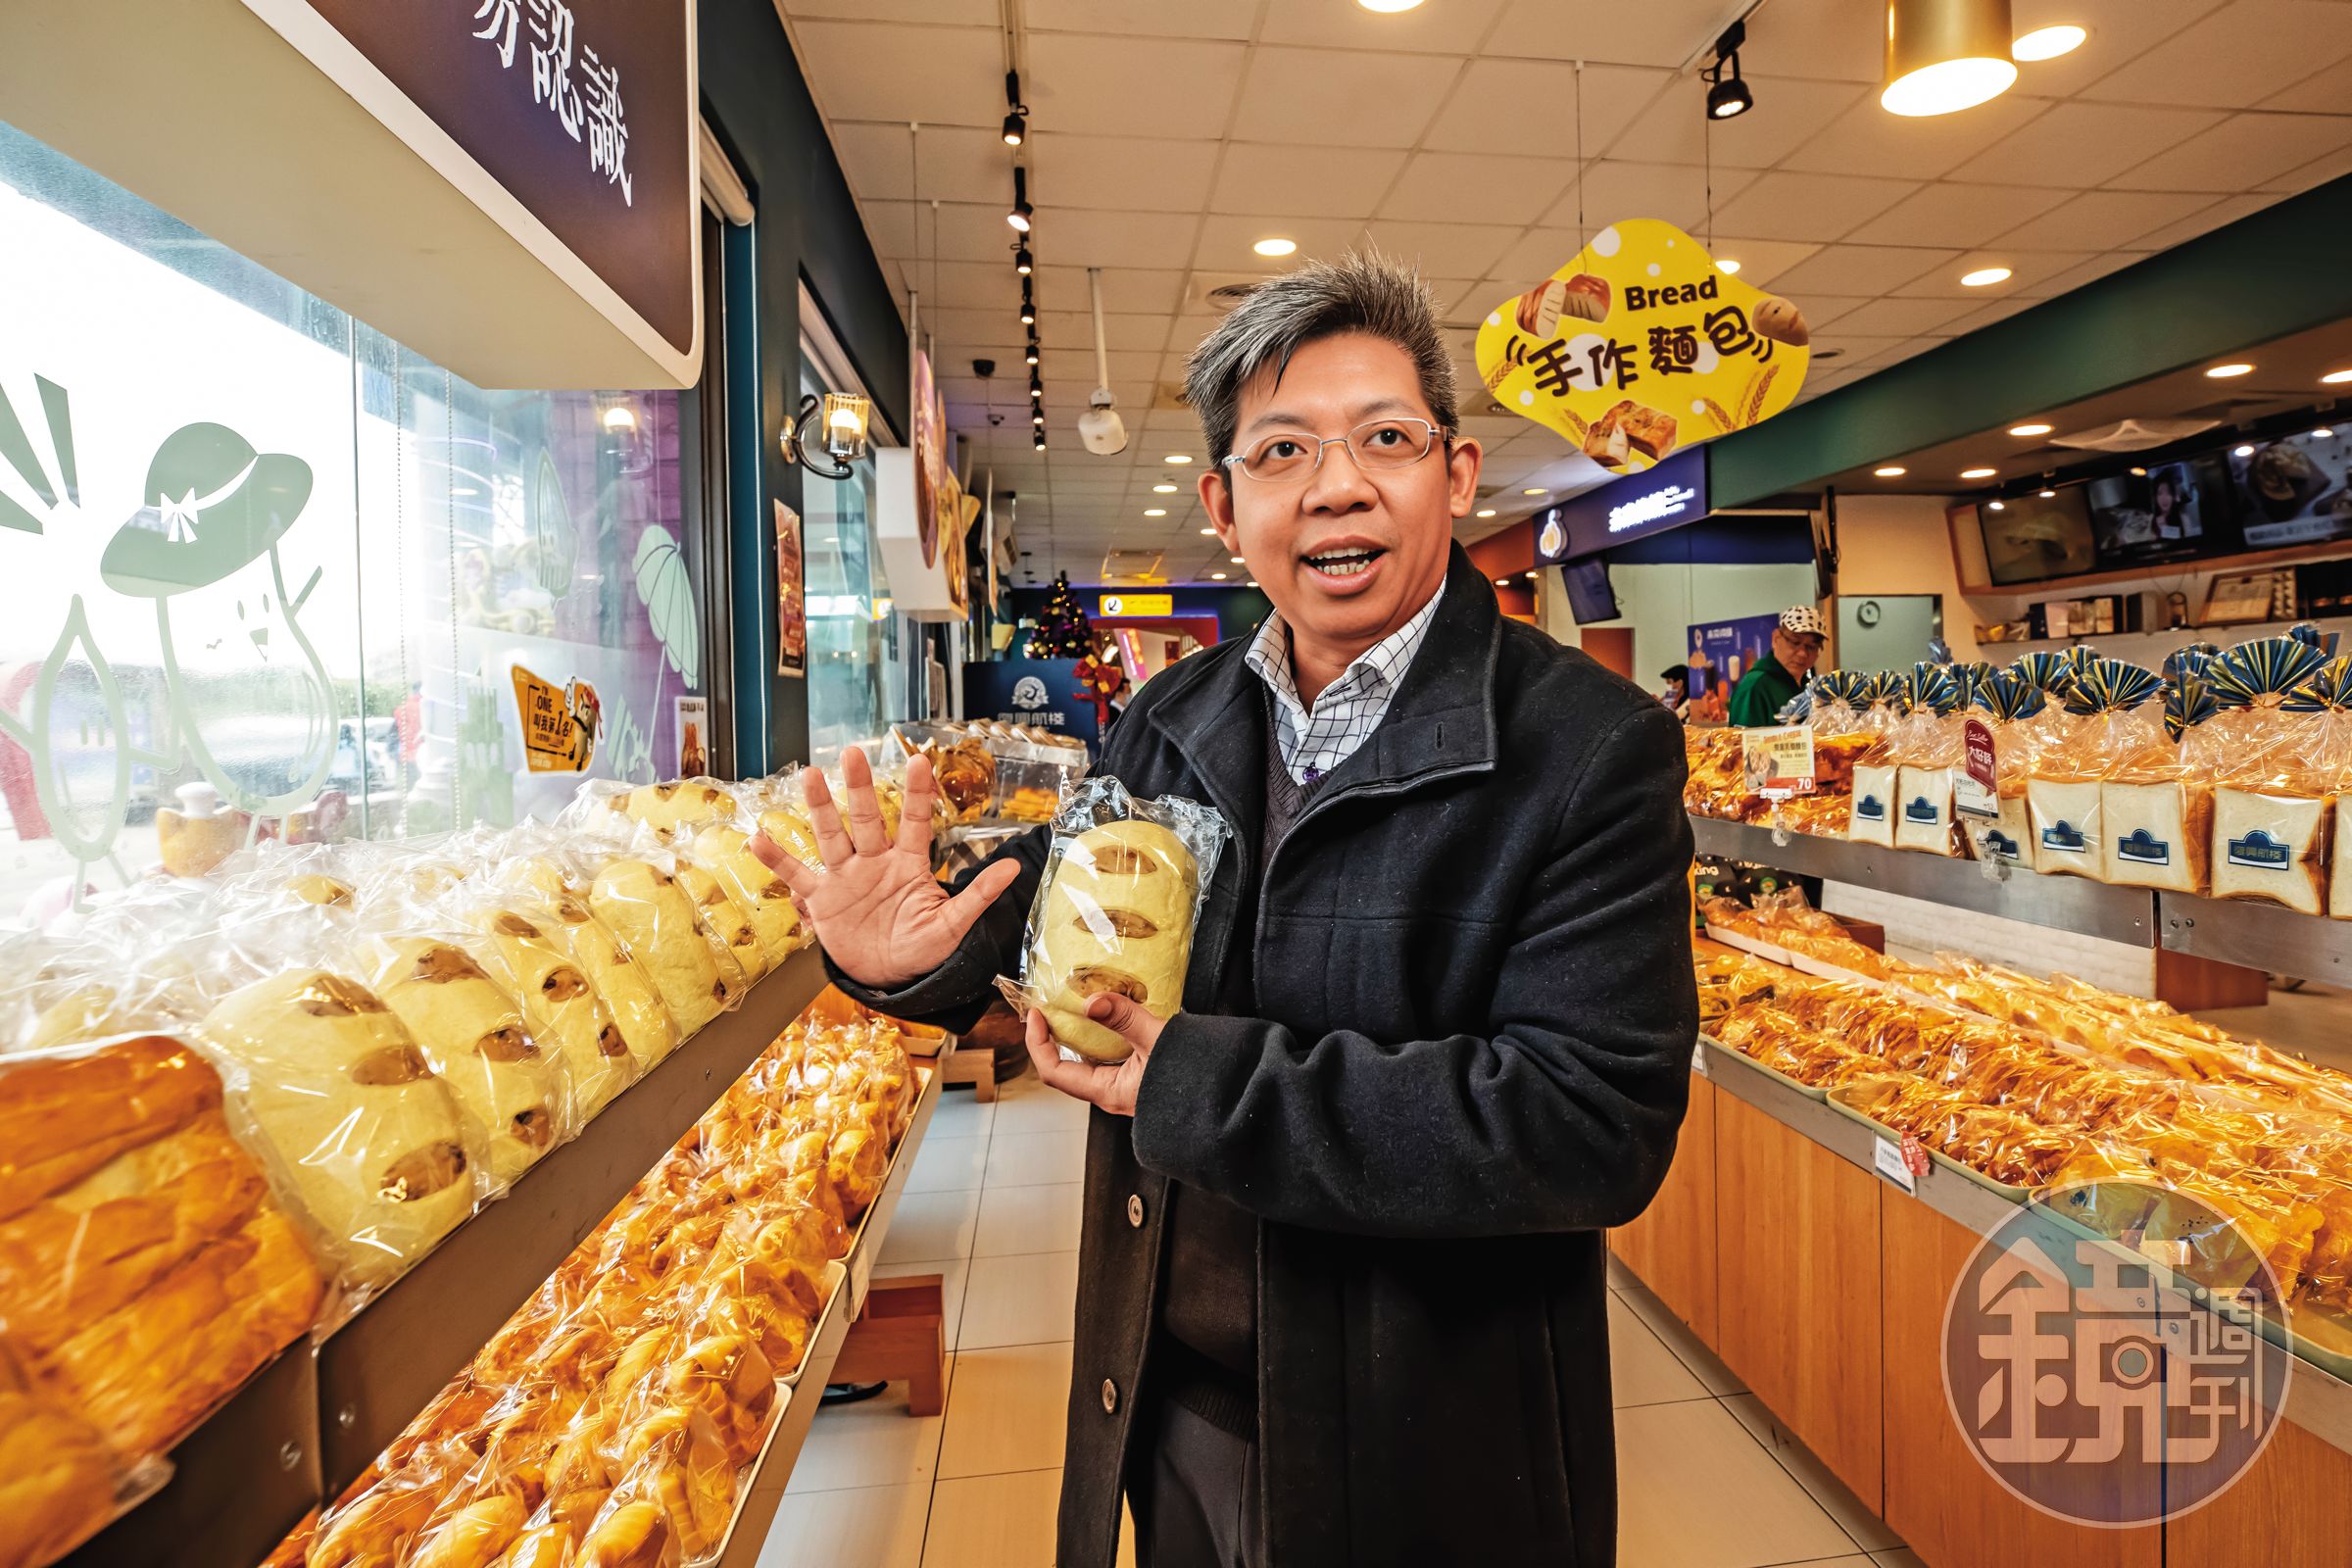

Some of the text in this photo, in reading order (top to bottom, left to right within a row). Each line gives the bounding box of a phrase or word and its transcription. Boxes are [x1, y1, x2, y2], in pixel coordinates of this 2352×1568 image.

[1624, 274, 1719, 312] Bread
[1526, 305, 1757, 398] 手作麵包
[536, 695, 553, 713] ONE
[1797, 777, 1812, 790] 70
